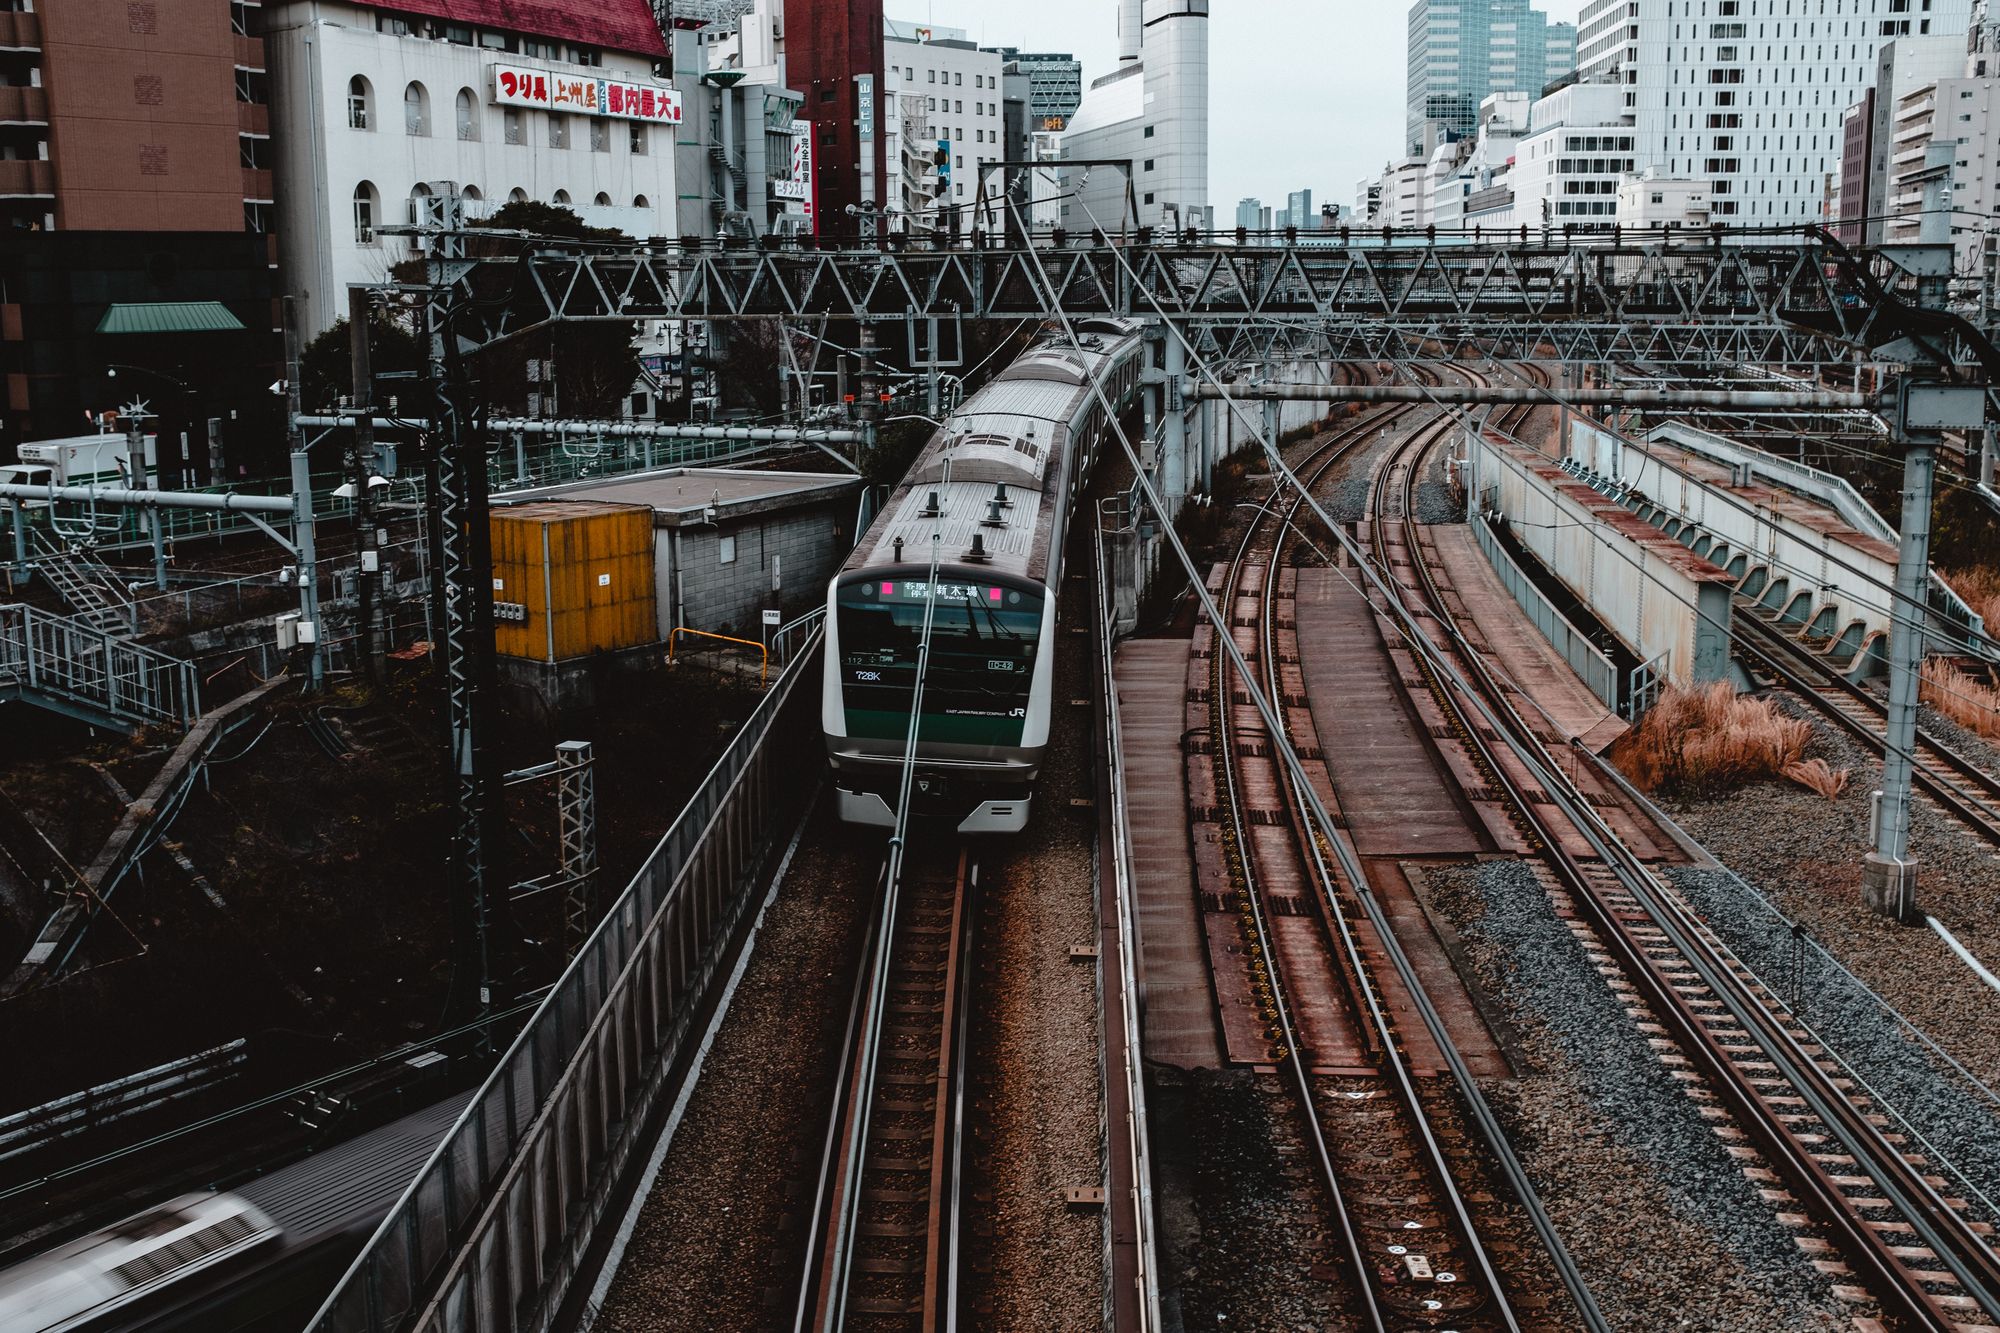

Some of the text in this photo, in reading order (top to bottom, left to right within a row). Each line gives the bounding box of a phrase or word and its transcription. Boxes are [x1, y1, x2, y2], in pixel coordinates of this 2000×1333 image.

[500, 71, 547, 102] つり具
[555, 79, 597, 107] 上州屋
[936, 585, 977, 597] 新木場
[856, 671, 880, 680] 728K
[1009, 708, 1024, 717] JR
